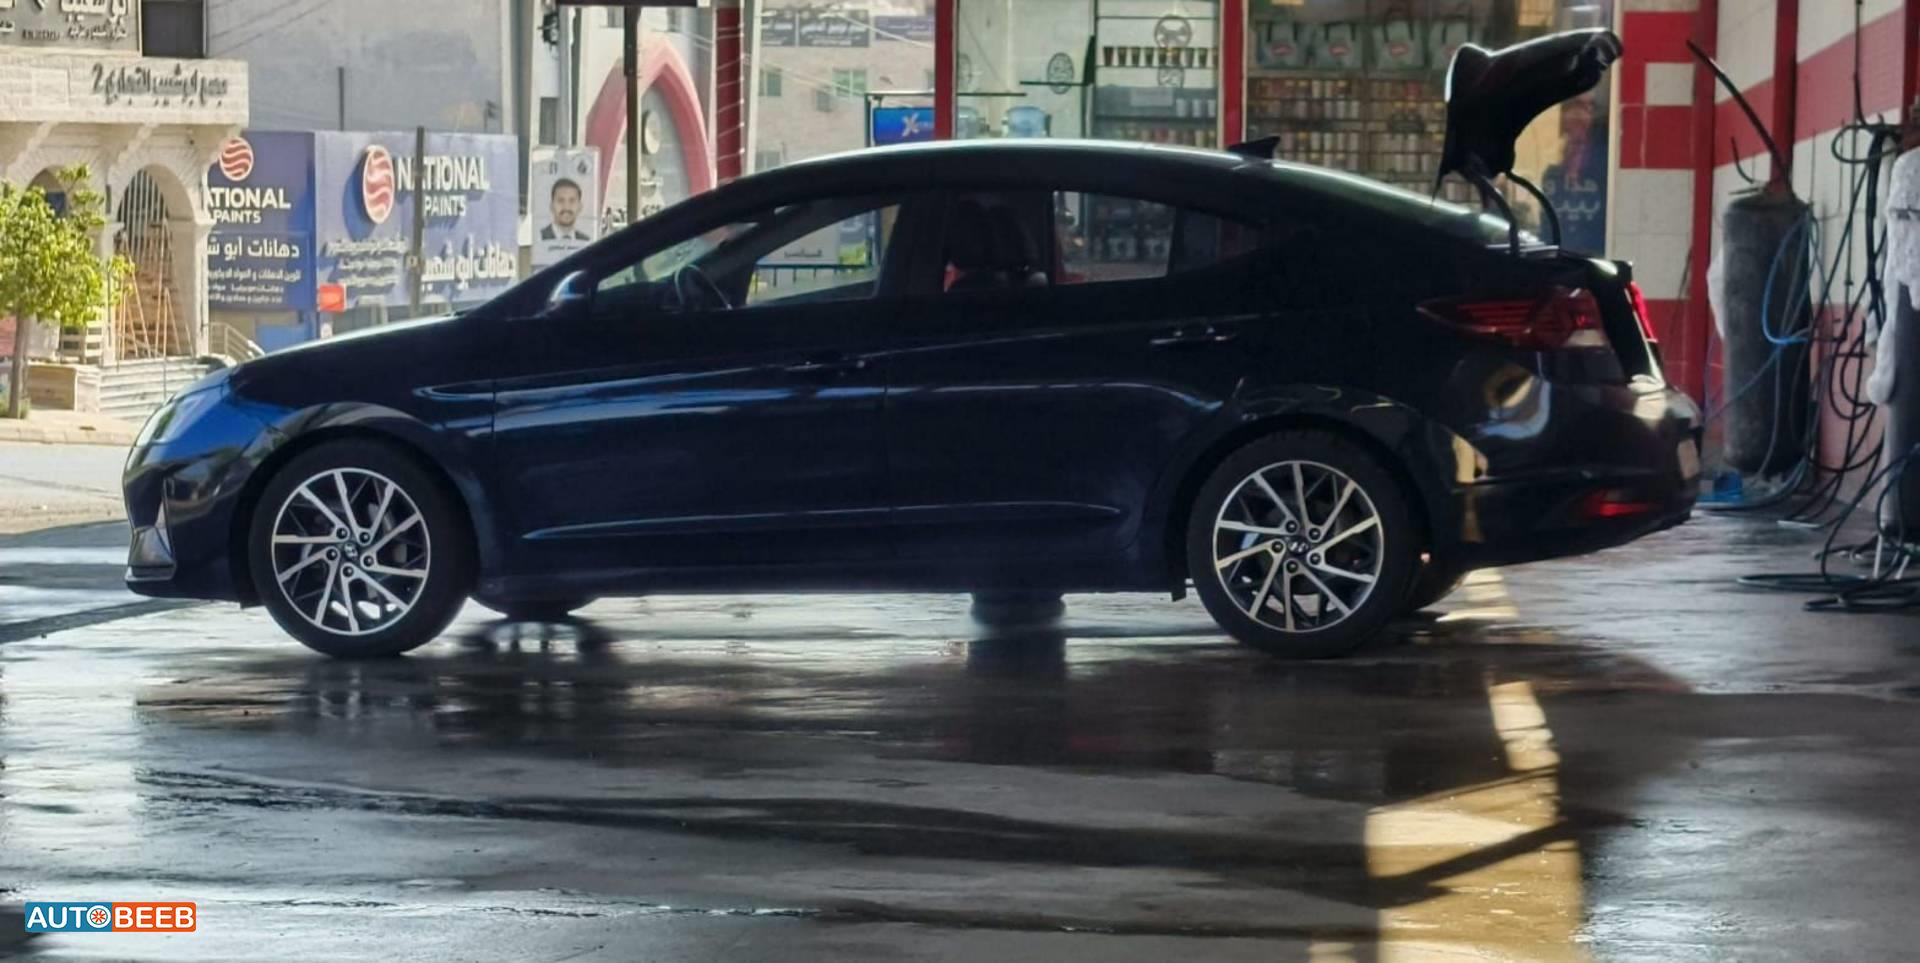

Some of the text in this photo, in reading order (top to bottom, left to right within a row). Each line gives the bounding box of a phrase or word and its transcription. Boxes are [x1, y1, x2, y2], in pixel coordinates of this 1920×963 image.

[397, 156, 491, 191] NTIONAL
[213, 209, 262, 224] PAINTS
[423, 195, 467, 217] PAINTS
[247, 238, 300, 258] دهانات
[421, 240, 455, 292] شعي
